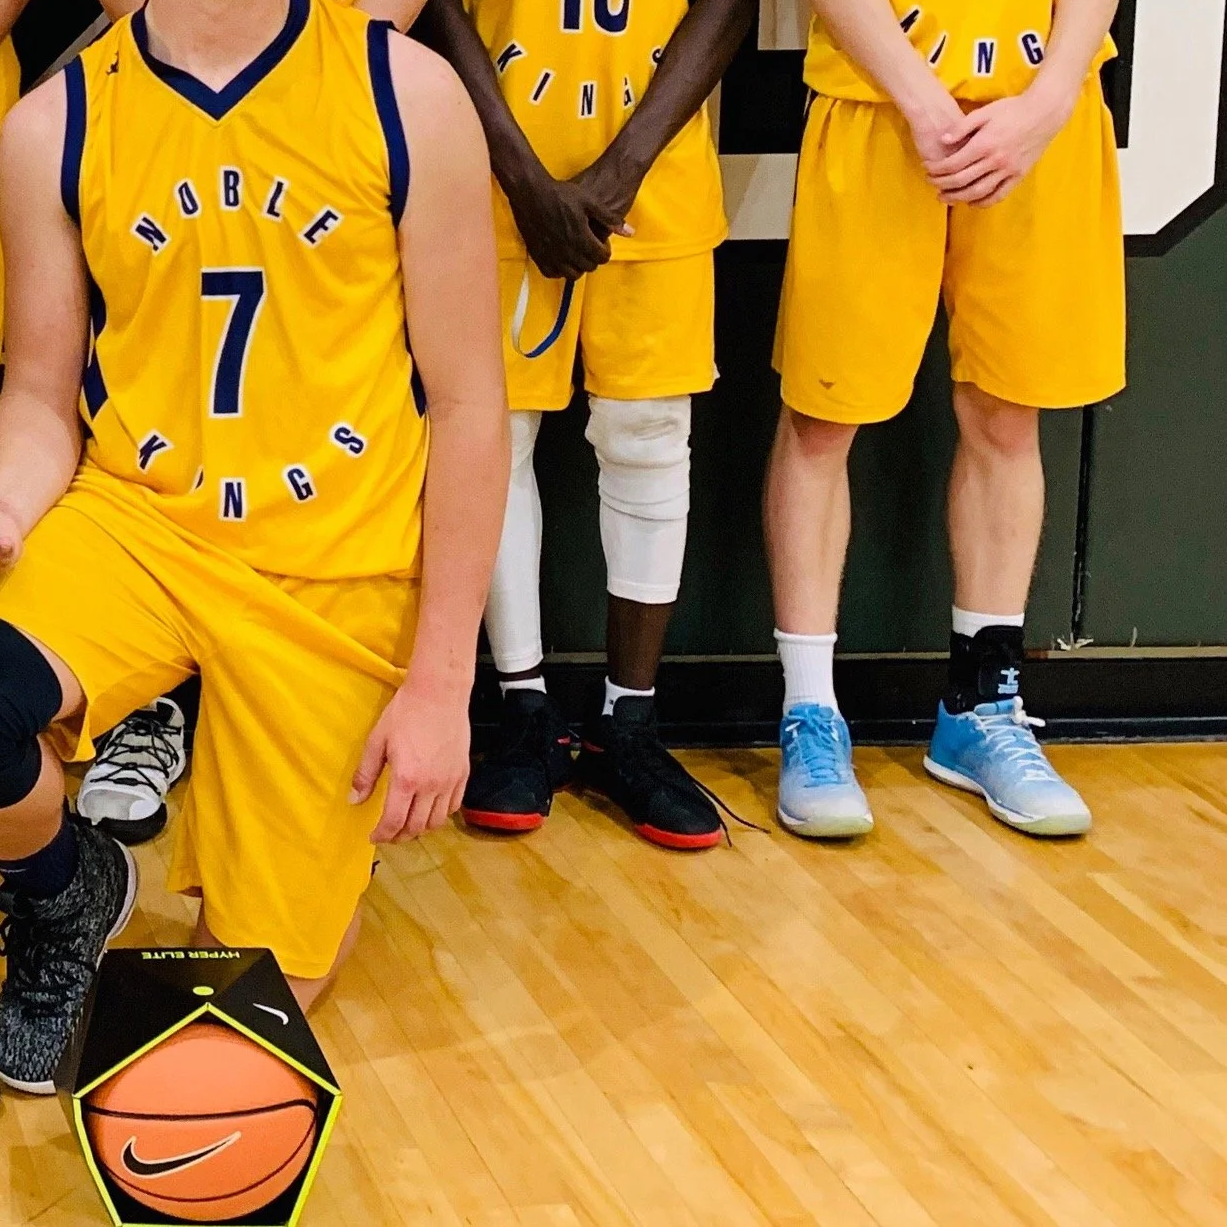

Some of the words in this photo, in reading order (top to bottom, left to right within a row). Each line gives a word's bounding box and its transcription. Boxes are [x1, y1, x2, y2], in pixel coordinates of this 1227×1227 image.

[899, 7, 1045, 77] ING
[133, 167, 342, 254] NOBLE
[200, 266, 266, 419] 7
[137, 420, 367, 521] KNGS
[141, 951, 185, 960] ELITE
[188, 951, 240, 959] HYPER
